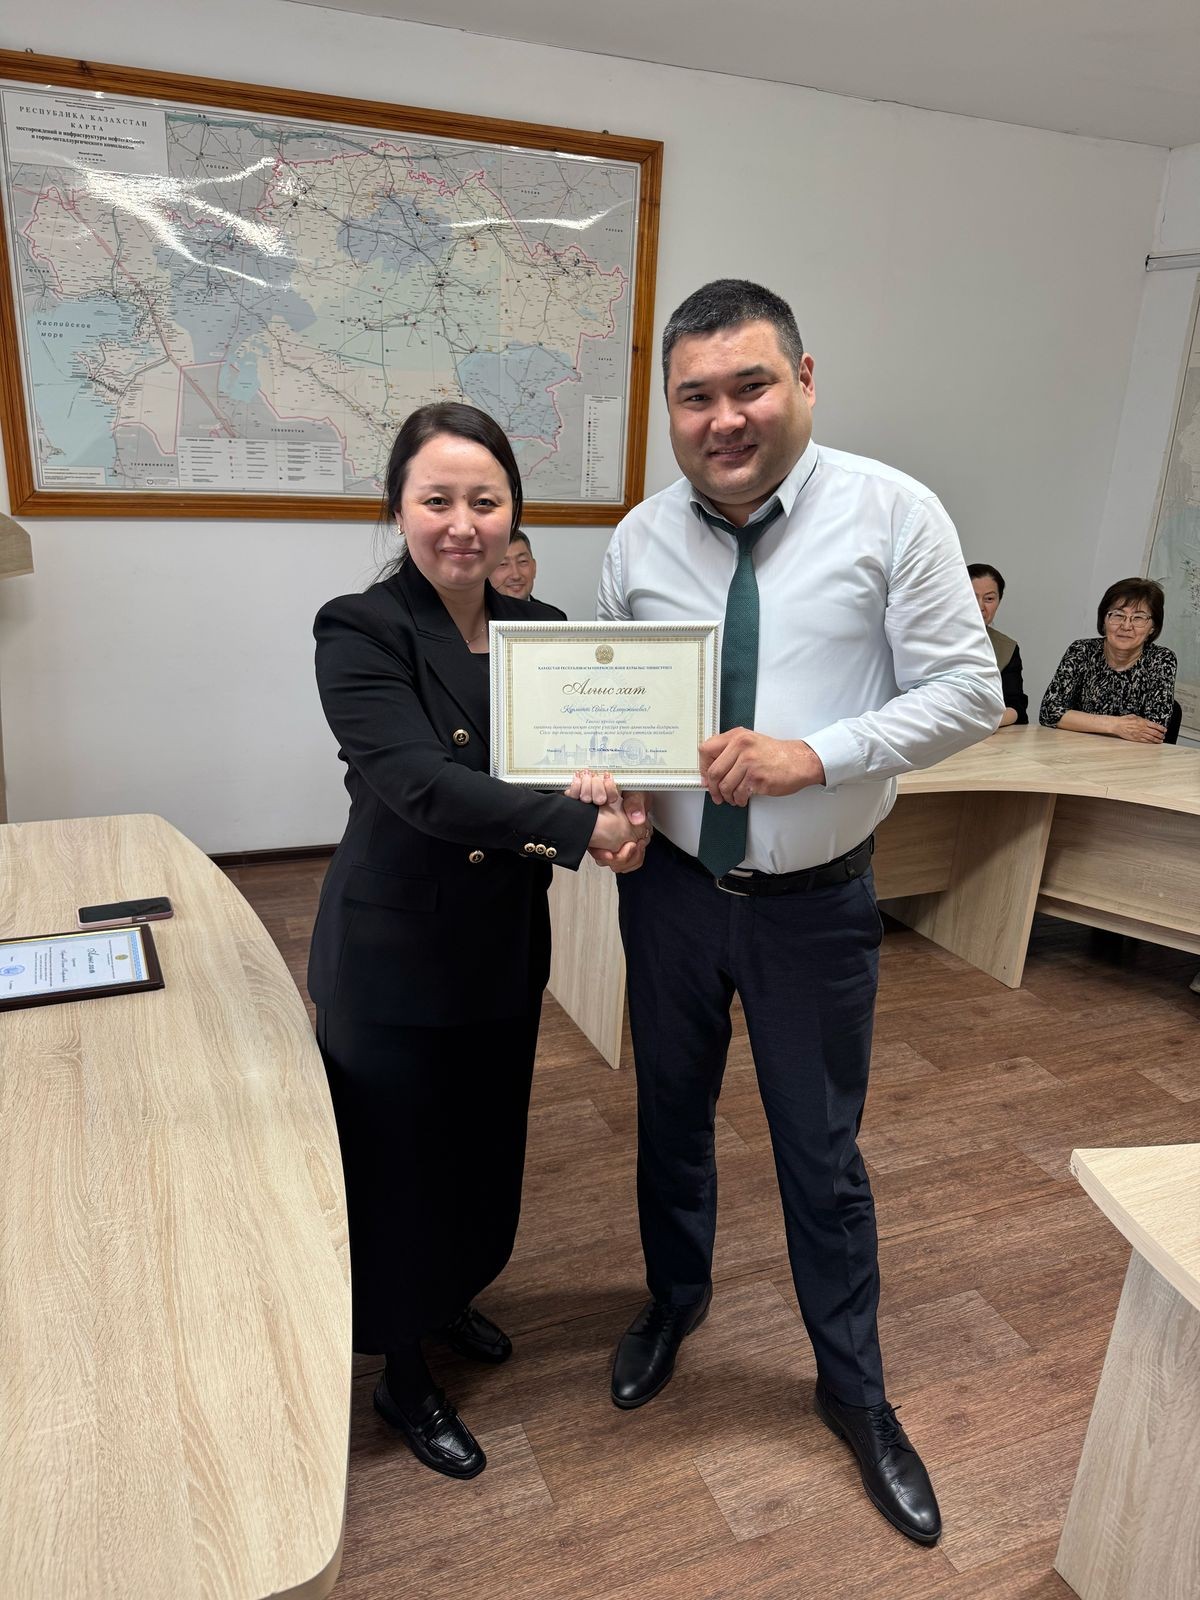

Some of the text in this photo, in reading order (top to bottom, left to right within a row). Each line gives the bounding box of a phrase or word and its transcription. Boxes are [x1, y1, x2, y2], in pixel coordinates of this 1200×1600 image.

[19, 105, 85, 120] РЕСПУБЛИКА
[90, 114, 148, 128] КАЗАХСТАН
[70, 122, 104, 132] КАРТА
[37, 319, 91, 329] Каспийское
[41, 331, 64, 340] море
[615, 685, 647, 695] хат
